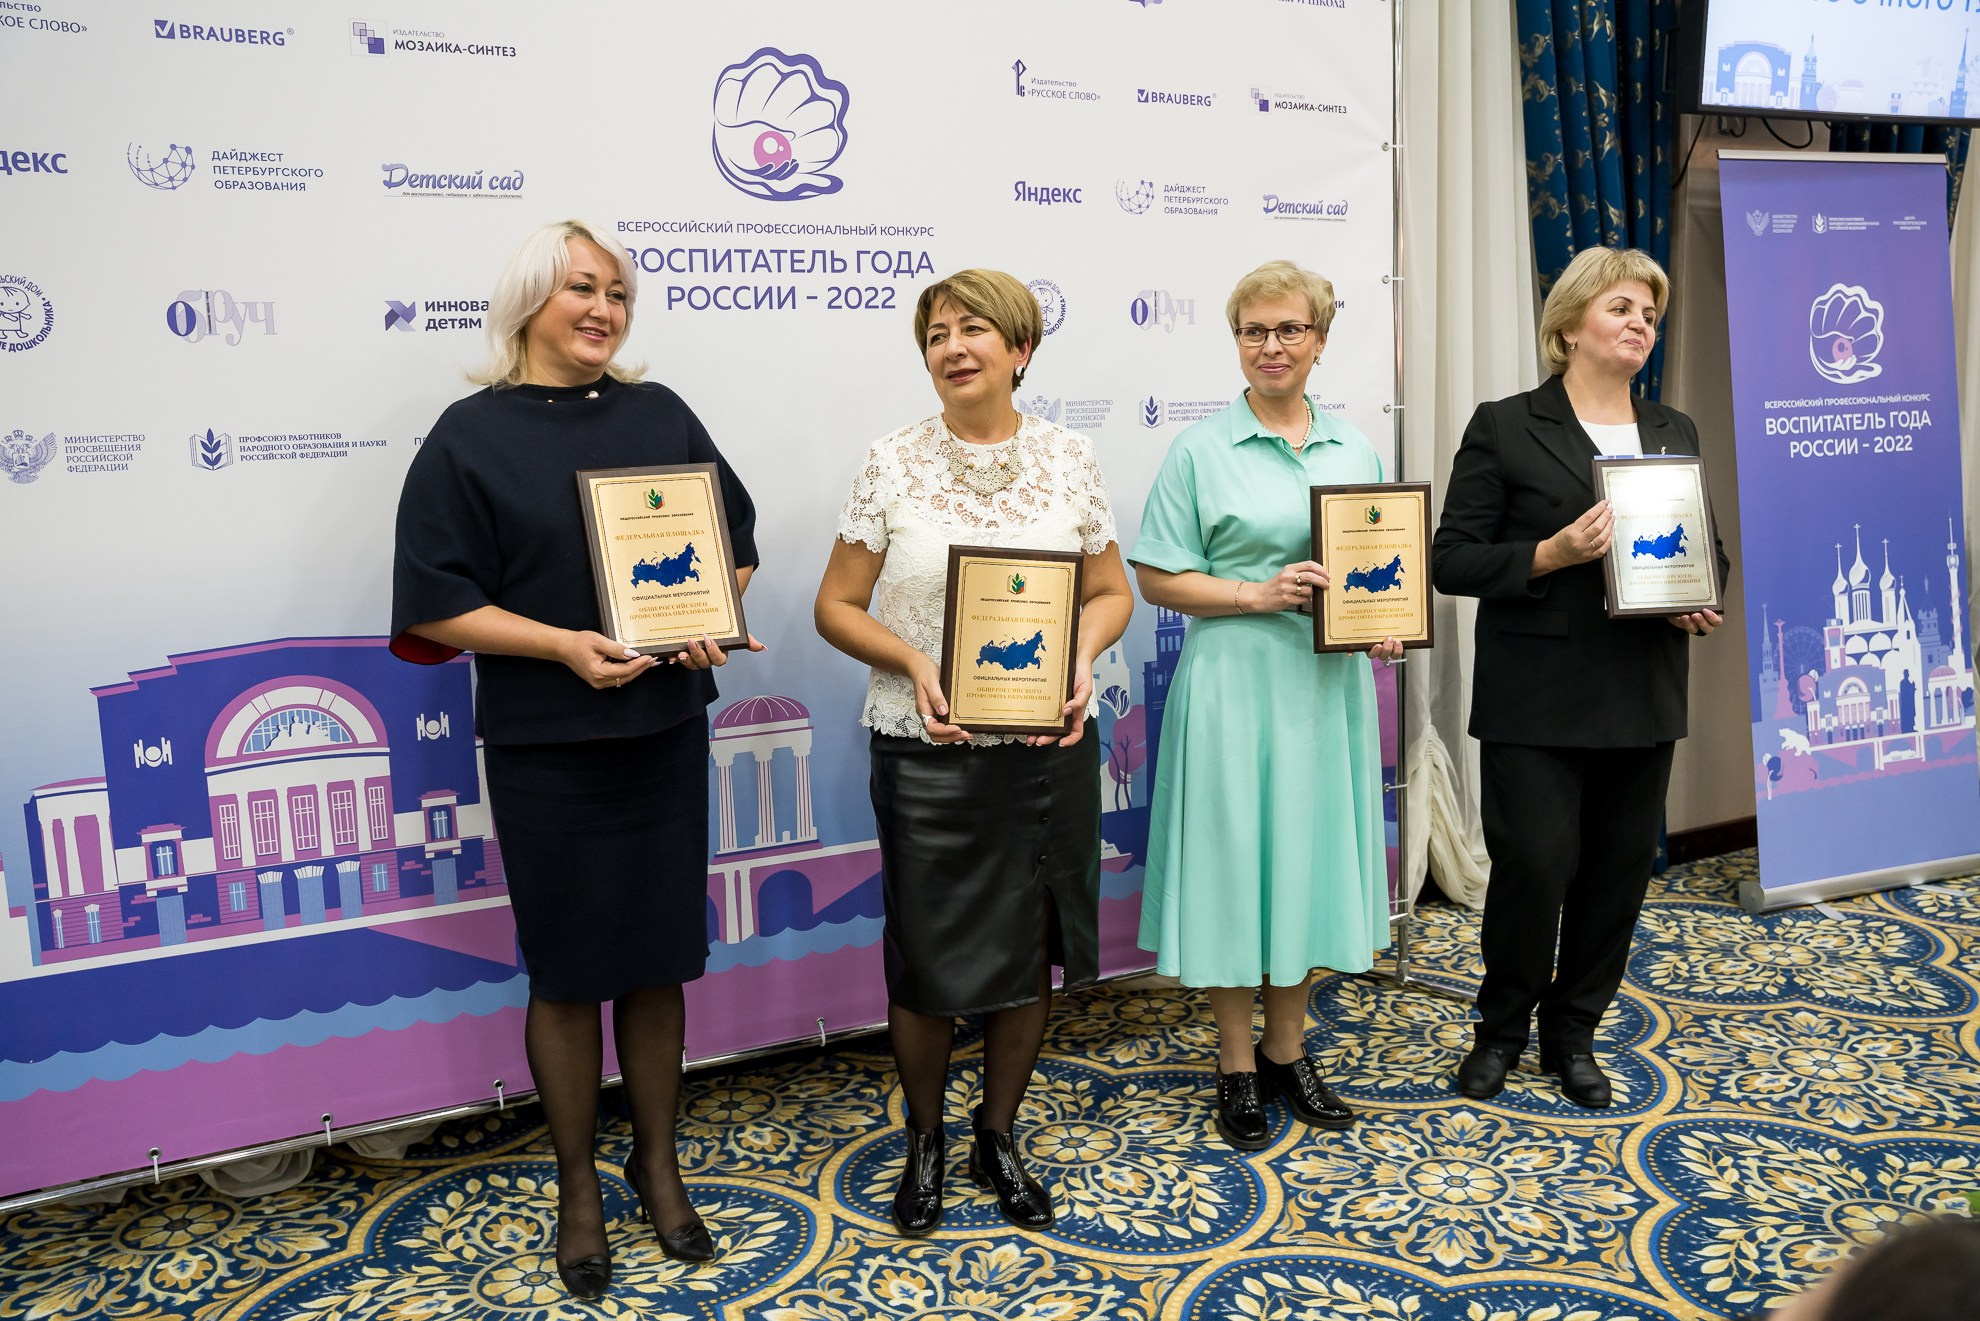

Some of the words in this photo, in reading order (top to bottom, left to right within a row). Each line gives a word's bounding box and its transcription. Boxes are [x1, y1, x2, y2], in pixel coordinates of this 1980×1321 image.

[29, 18, 88, 34] СЛОВО»
[392, 28, 445, 38] ИЗДАТЕЛЬСТВО
[394, 40, 517, 57] МОЗАИКА-СИНТЕЗ
[1031, 77, 1077, 88] Издательство
[1028, 88, 1067, 99] «РУССКОЕ
[1069, 91, 1101, 101] СЛОВО»
[1274, 101, 1347, 114] МОЗАИКА-СИНТЕЗ
[211, 148, 284, 163] ДАЙДЖЕСТ
[213, 166, 324, 178] ПЕТЕРБУРГСКОГО
[381, 163, 483, 190] Детский
[488, 170, 525, 191] сад
[214, 180, 306, 192] ОБРАЗОВАНИЯ
[1164, 183, 1206, 194] ДАЙДЖЕСТ
[1014, 180, 1082, 205] Яндекс
[1164, 196, 1229, 206] ПЕТЕРБУРГСКОГО
[1262, 194, 1323, 214] Детский
[1326, 200, 1348, 215] сад
[1164, 207, 1218, 216] ОБРАЗОВАНИЯ
[617, 220, 733, 233] ВСЕРОССИЙСКИЙ
[736, 222, 878, 236] ПРОФЕССИОНАЛЬНЫЙ
[880, 227, 934, 237] КОНКУРС
[857, 250, 935, 278] ГОДА
[25, 281, 43, 297] ДОМ
[667, 286, 796, 310] РОССИИ
[827, 286, 896, 310] 2022
[424, 300, 489, 312] иннова
[8, 300, 54, 353] ДОШКОЛЬНИКА
[425, 317, 482, 331] детям
[1765, 398, 1823, 409] ВСЕРОССИЙСКИЙ
[1824, 394, 1900, 406] ПРОФЕССИОНАЛЬНЫЙ
[1902, 393, 1931, 402] КОНКУРС
[1765, 412, 1886, 435] ВОСПИТАТЕЛЬ
[1890, 410, 1932, 430] ГОДА
[64, 434, 146, 444] МИНИСТЕРСТВО
[239, 435, 287, 443] ПРОФСОЮЗ
[288, 433, 342, 441] РАБОТНИКОВ
[65, 443, 142, 454] ПРОСВЕЩЕНИЯ
[240, 444, 291, 452] НАРОДНОГО
[292, 441, 350, 450] ОБРАЗОВАНИЯ
[1790, 438, 1858, 458] РОССИИ
[1873, 435, 1913, 453] 2022
[66, 453, 133, 463] РОССИЙСКОЙ
[240, 452, 297, 461] РОССИЙСКОЙ
[298, 450, 348, 459] ФЕДЕРАЦИИ
[66, 463, 129, 473] ФЕДЕРАЦИИ
[615, 532, 665, 541] ФЕДЕРАЛЬНАЯ
[665, 529, 705, 538] ПЛОЩАДКА
[672, 589, 710, 598] МЕРОПРИЯТИЙ
[639, 601, 708, 613] ОБЩЕРОССИЙСКОГО
[629, 611, 672, 620] ПРОФСОЮЗА
